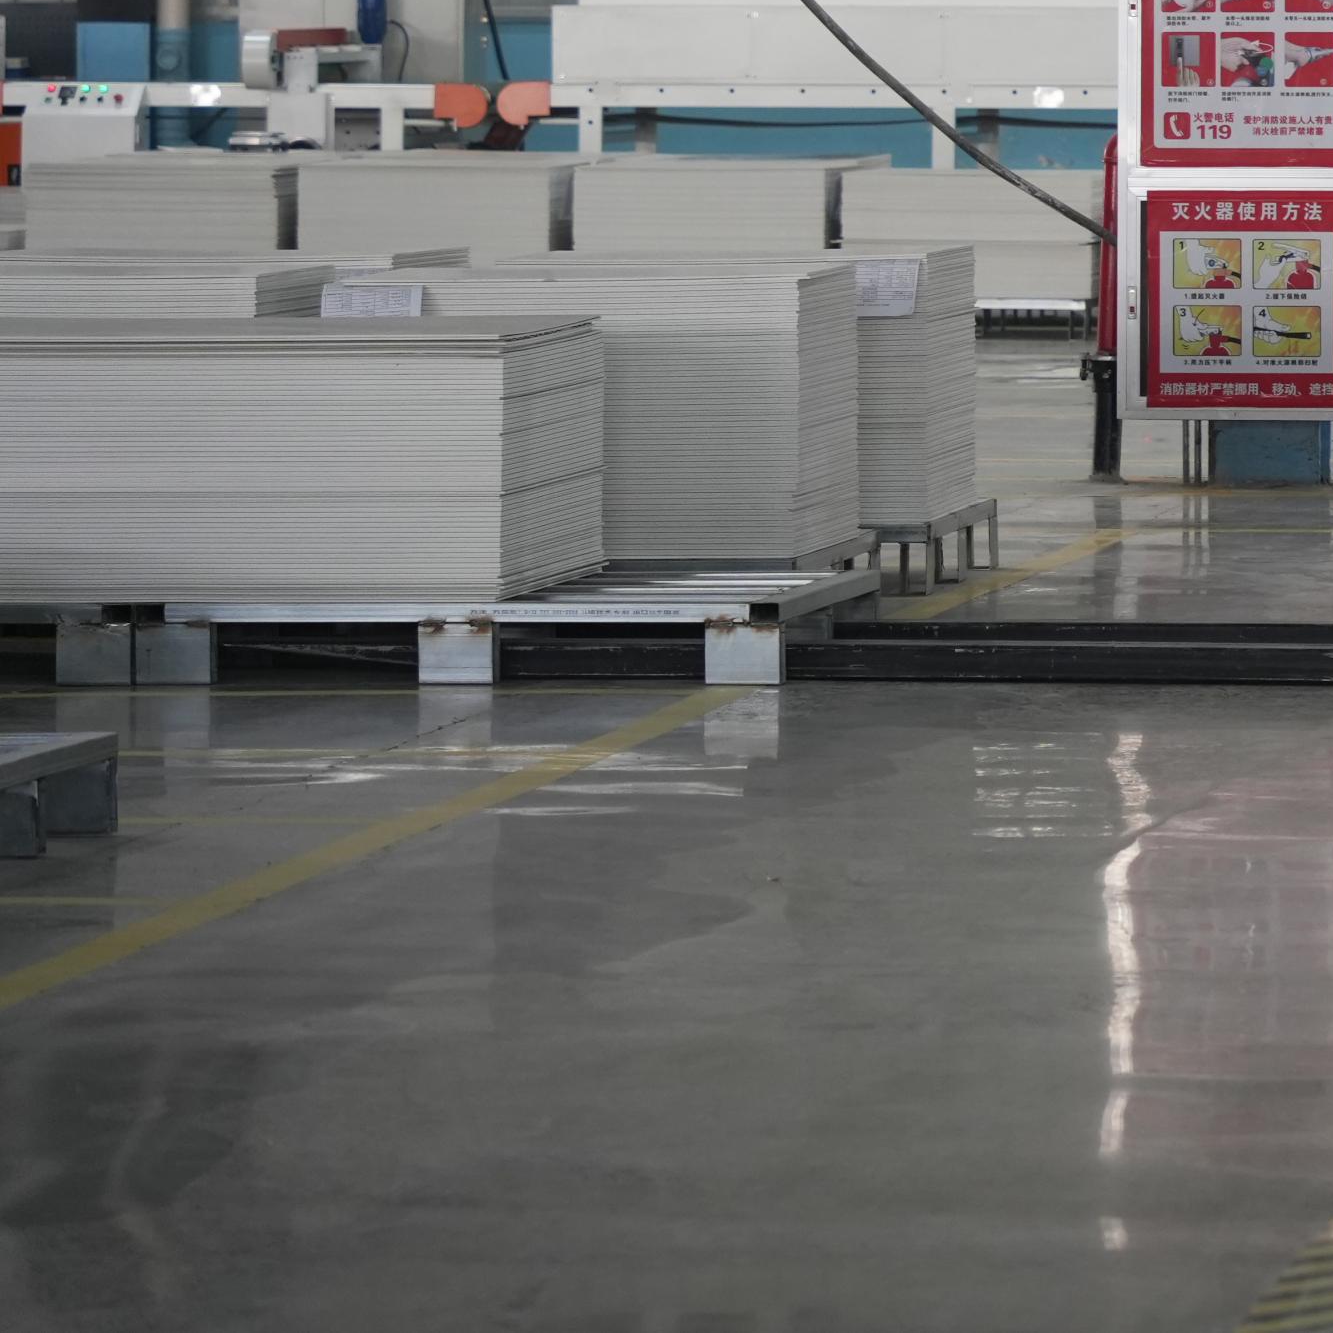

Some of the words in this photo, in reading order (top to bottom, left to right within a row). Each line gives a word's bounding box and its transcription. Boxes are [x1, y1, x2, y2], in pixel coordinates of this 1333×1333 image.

[1193, 112, 1235, 123] 火警电话
[1196, 124, 1232, 140] 119
[1172, 202, 1323, 221] 灭火器使用方法
[1179, 241, 1184, 250] 1
[1257, 241, 1265, 250] 2
[1180, 308, 1187, 317] 3
[1258, 308, 1267, 317] 4
